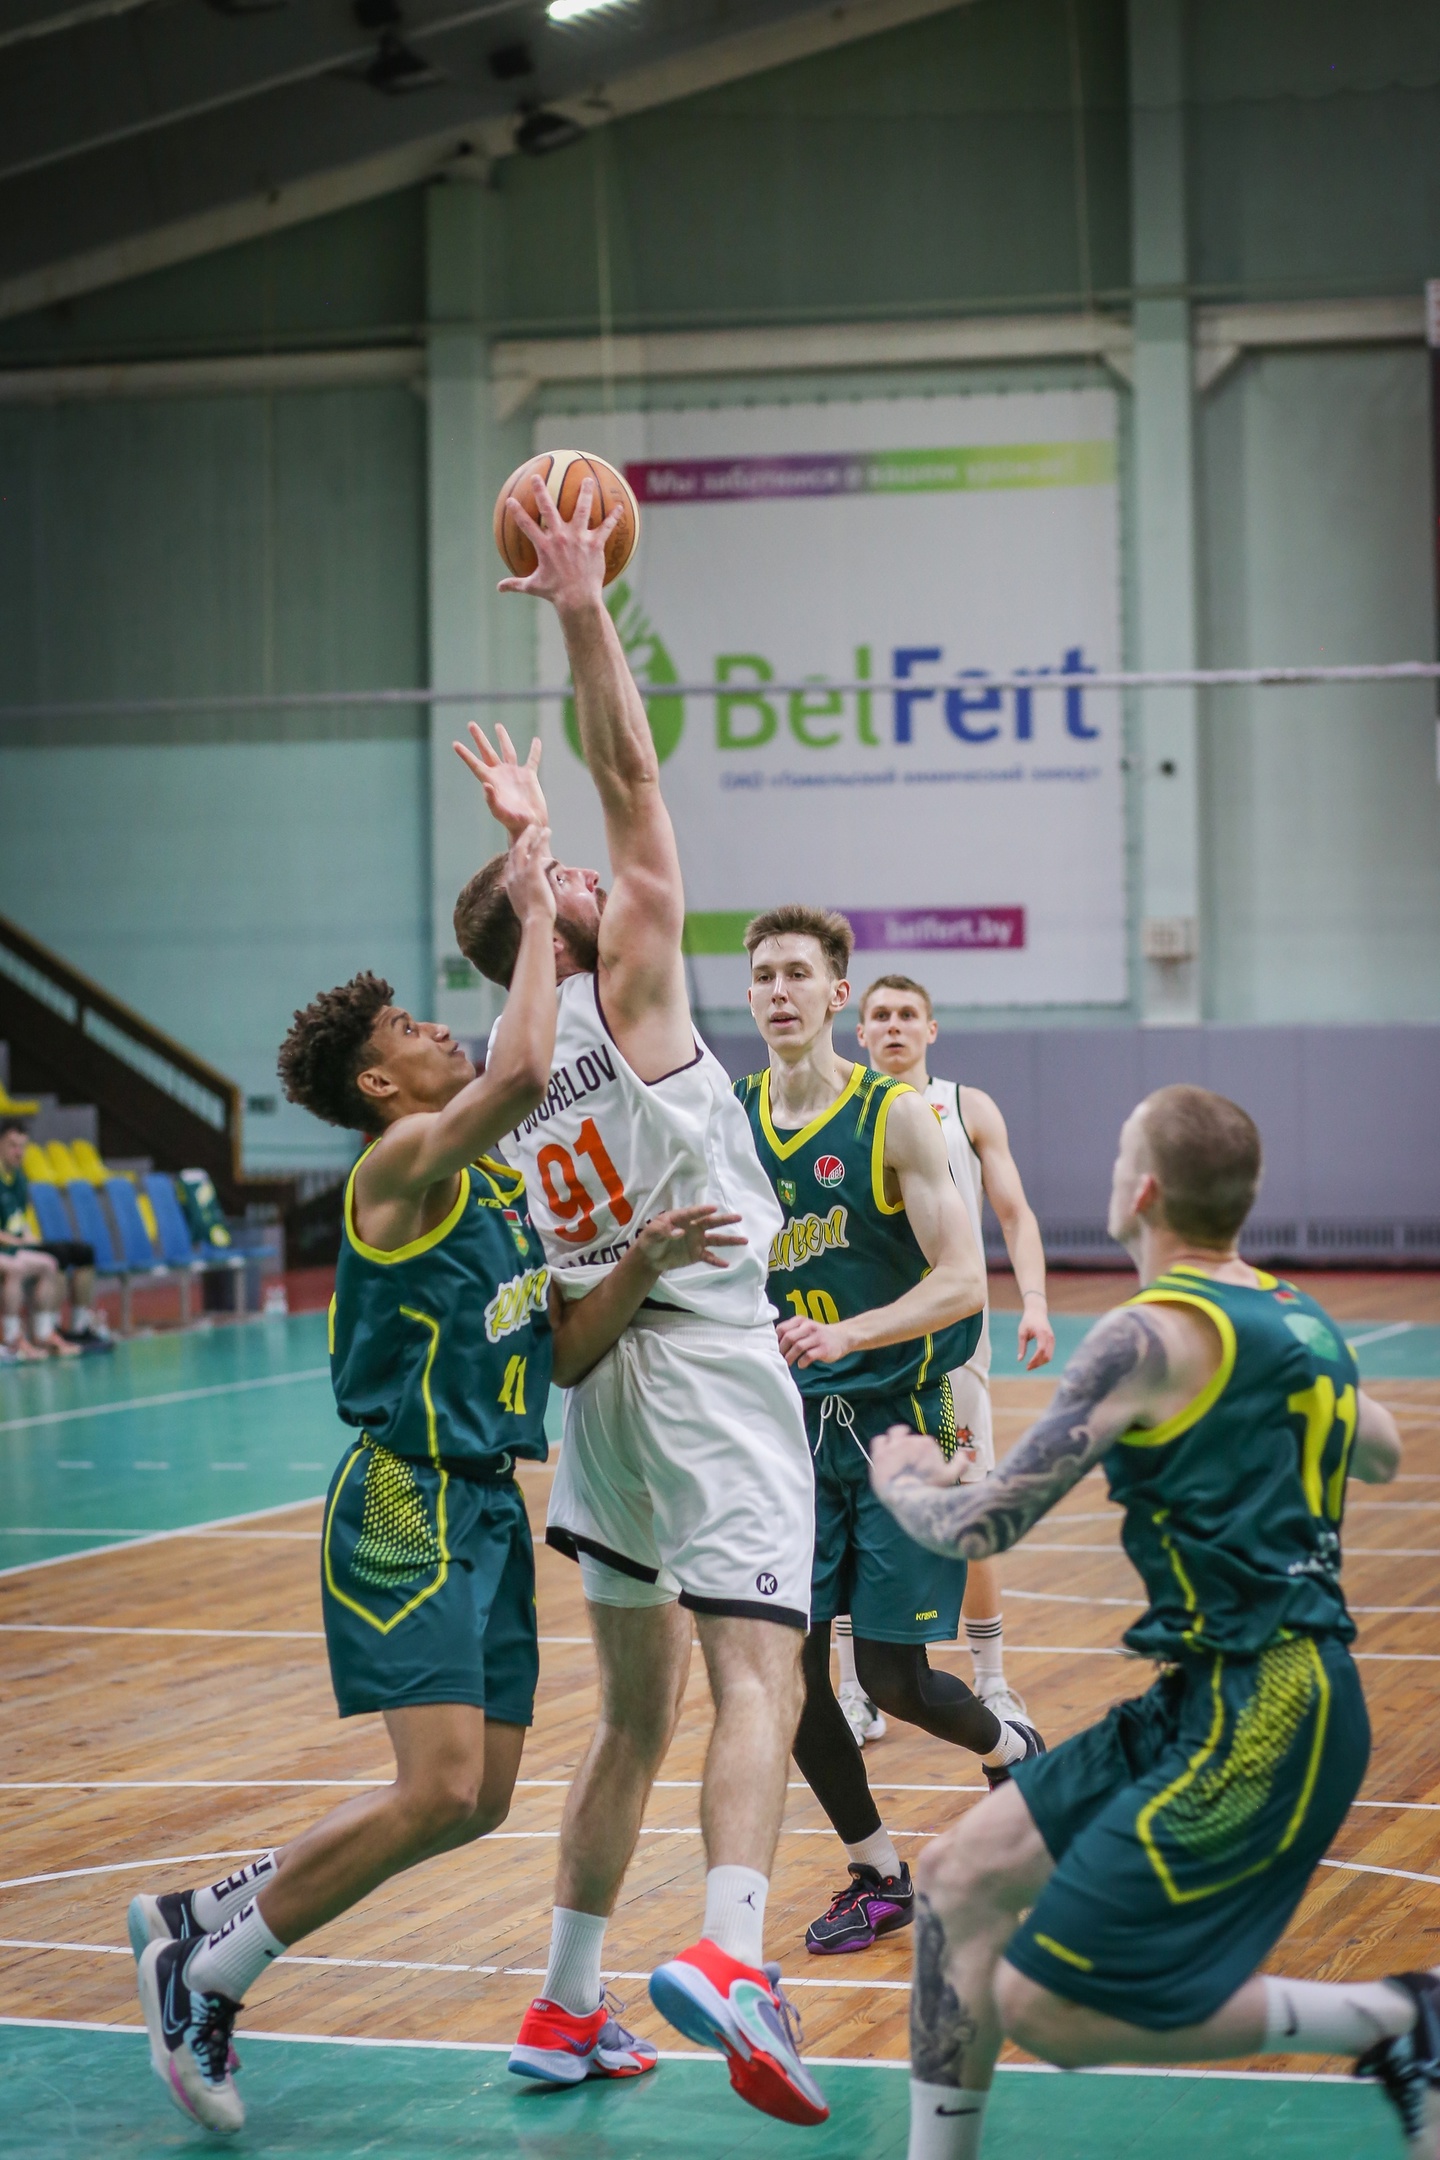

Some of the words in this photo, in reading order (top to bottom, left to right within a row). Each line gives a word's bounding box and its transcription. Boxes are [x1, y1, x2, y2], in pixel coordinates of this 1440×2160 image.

[714, 644, 1100, 751] BelFert
[537, 1118, 634, 1243] 91
[786, 1289, 841, 1325] 10
[1287, 1374, 1358, 1522] 11
